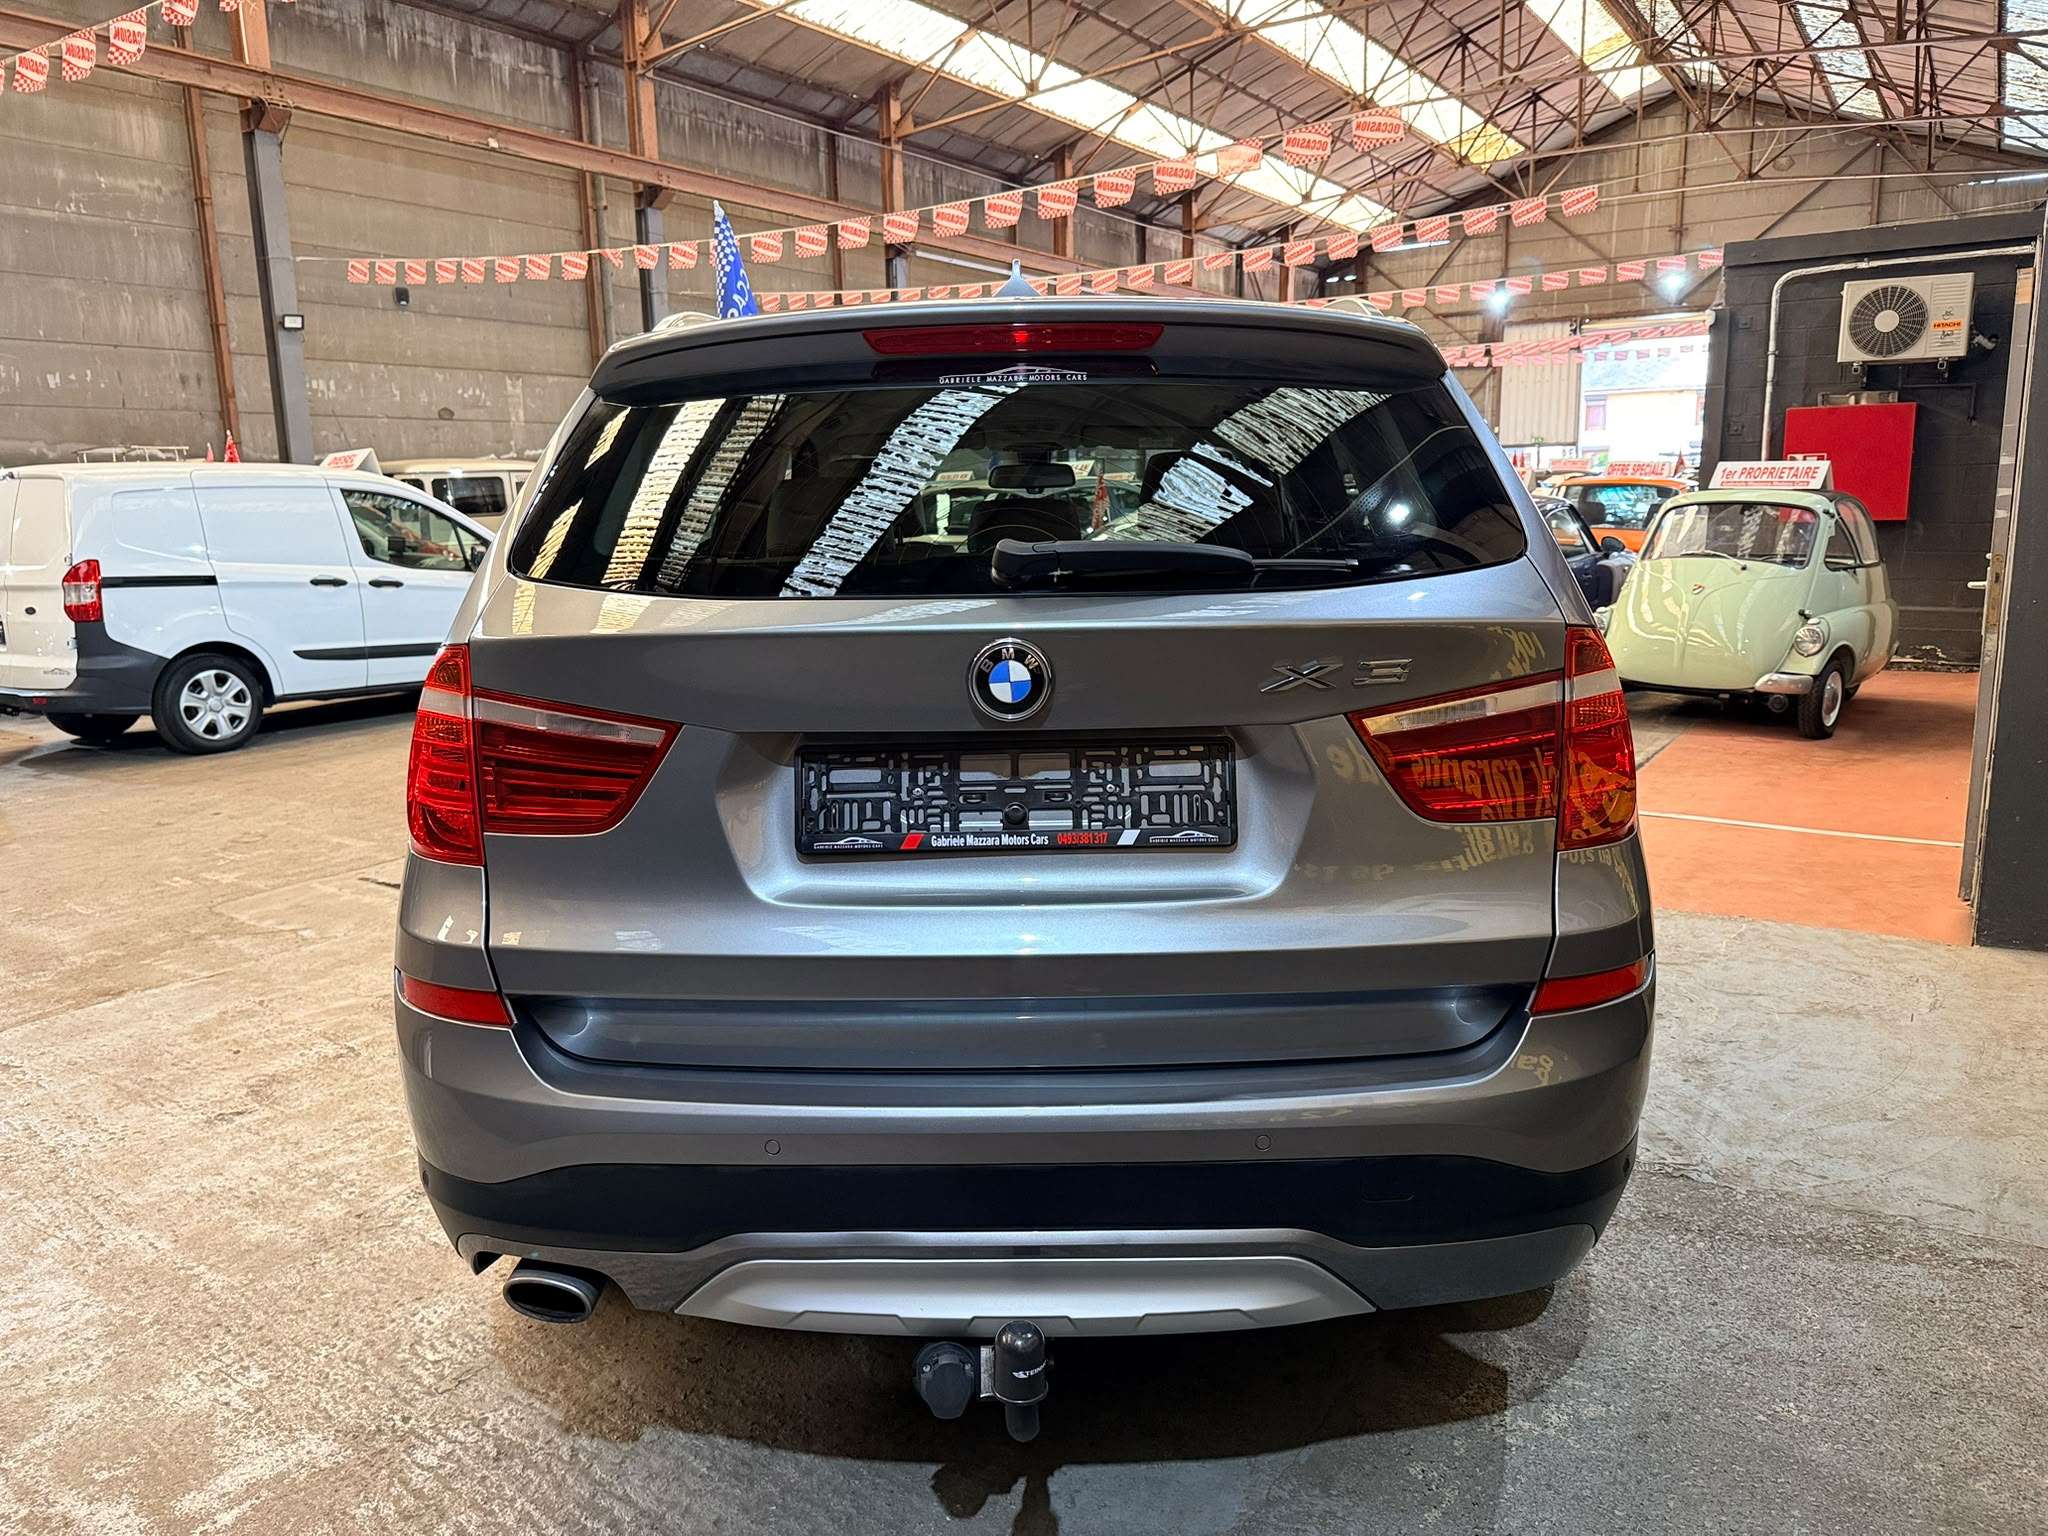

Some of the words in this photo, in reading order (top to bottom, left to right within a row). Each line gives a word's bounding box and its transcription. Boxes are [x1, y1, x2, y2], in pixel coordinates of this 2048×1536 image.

[1933, 321, 1962, 329] HITACHI
[939, 377, 981, 385] GABRIELE
[1028, 374, 1061, 382] MOTORS
[1721, 467, 1738, 479] 1er
[1739, 466, 1820, 480] PROPRIETAIRE
[980, 647, 1039, 673] BMW
[1260, 659, 1413, 693] X3
[931, 835, 965, 847] Gabriele
[966, 834, 1000, 846] Mazzara
[1001, 833, 1030, 846] Motors
[1030, 833, 1049, 846] Cars
